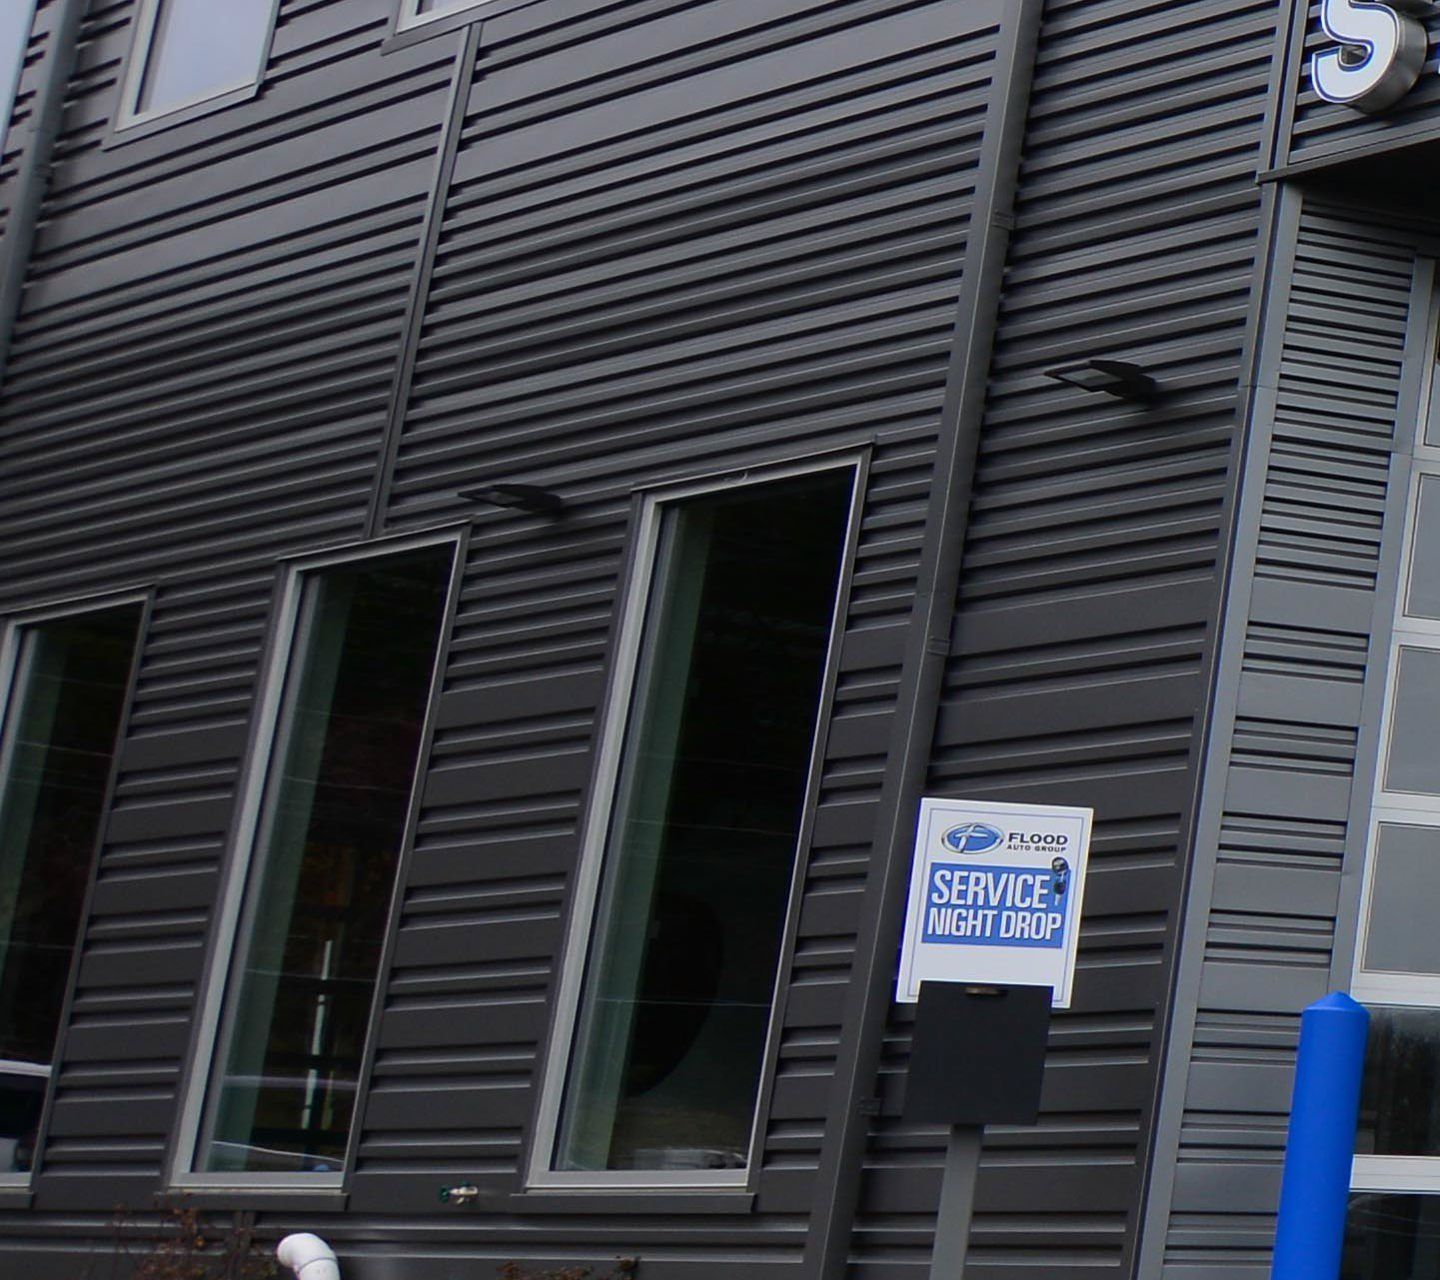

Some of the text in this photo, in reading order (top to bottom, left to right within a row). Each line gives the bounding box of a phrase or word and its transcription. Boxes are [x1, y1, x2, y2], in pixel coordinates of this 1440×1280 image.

[1007, 844, 1067, 853] AUTO GROUP
[1008, 832, 1068, 846] FLOOD
[931, 869, 1050, 909] SERVICE
[927, 907, 1062, 940] NIGHT DROP
